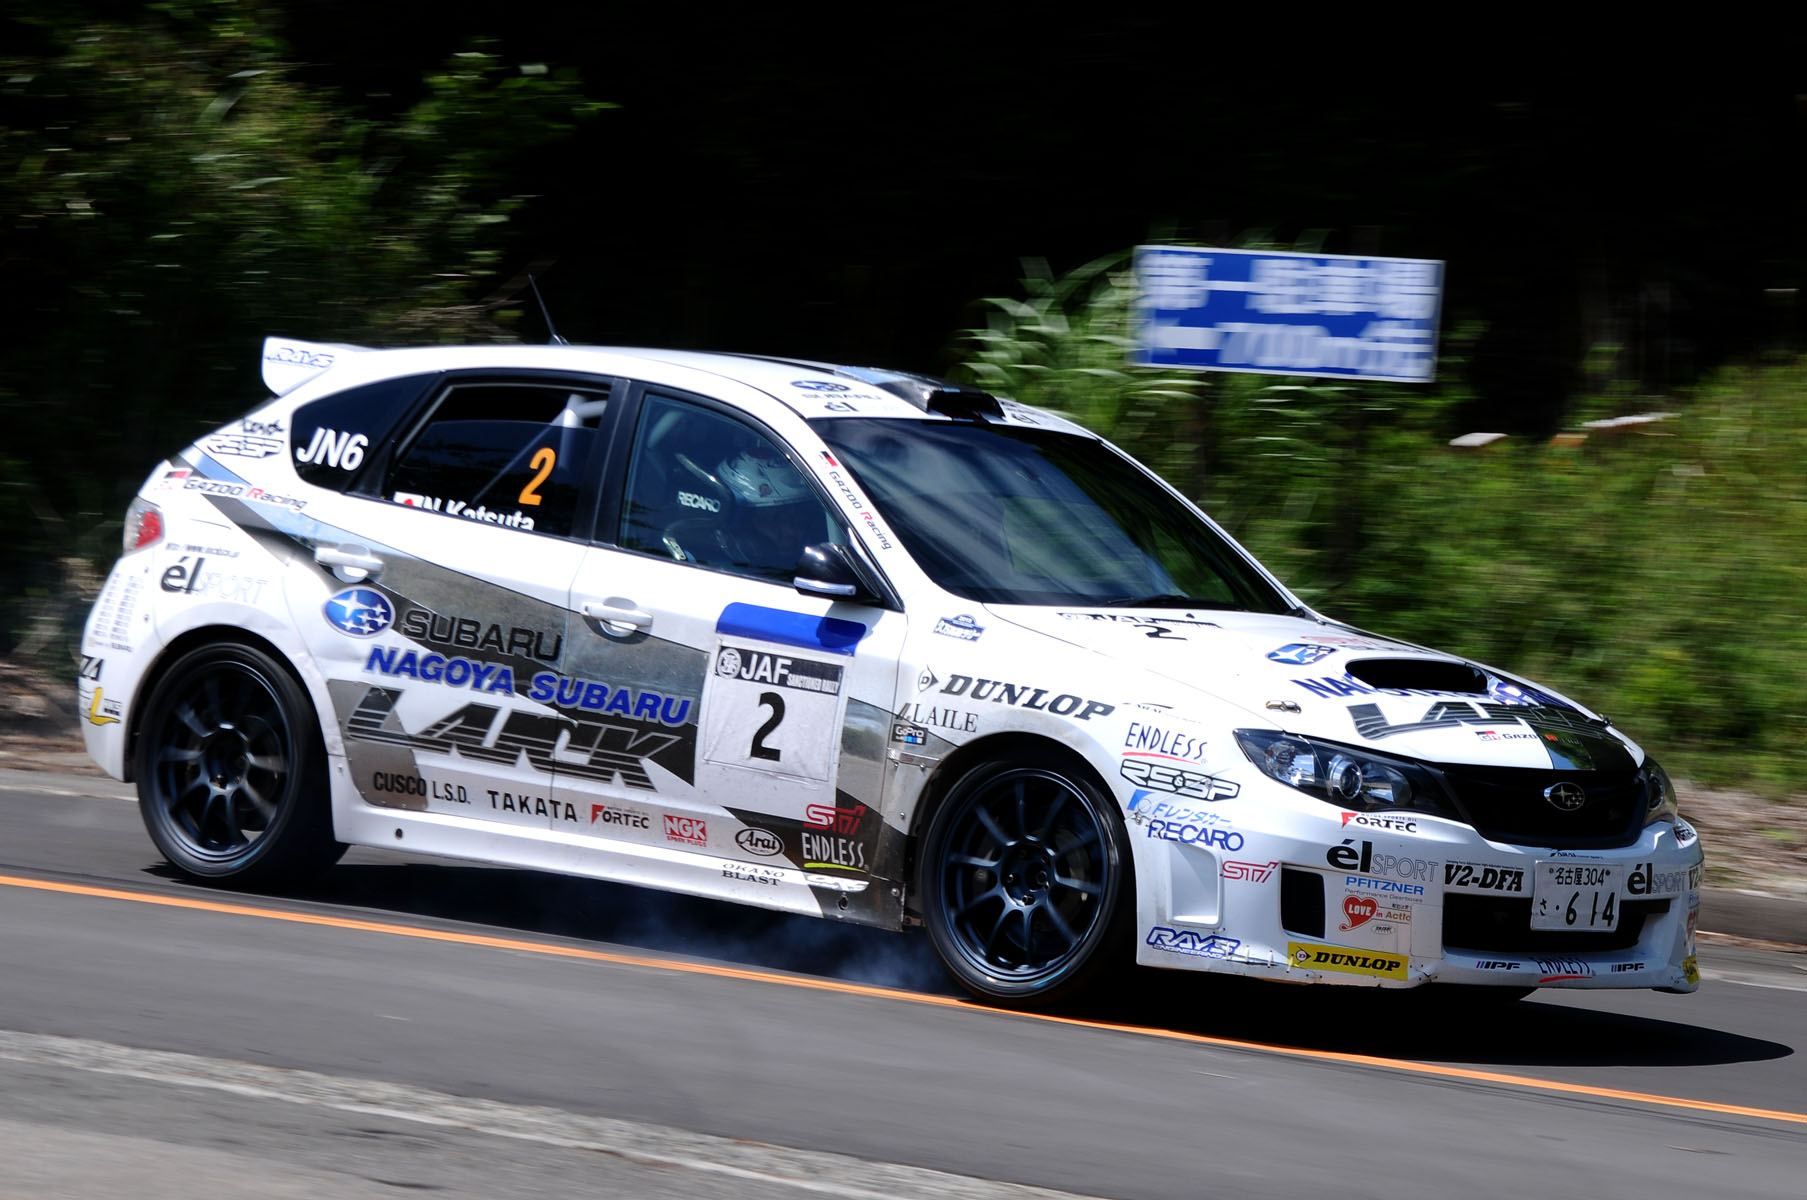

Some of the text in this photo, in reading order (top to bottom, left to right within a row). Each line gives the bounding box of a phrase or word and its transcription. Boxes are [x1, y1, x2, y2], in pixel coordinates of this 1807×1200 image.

[296, 427, 369, 470] JN6
[518, 447, 556, 506] 2
[245, 488, 308, 511] Racing
[860, 511, 893, 551] Racing
[402, 609, 563, 662] SUBARU
[741, 653, 792, 684] JAF
[365, 646, 693, 726] NAGOYA SUBARU
[939, 673, 1116, 721] DUNLOP
[750, 692, 785, 762] 2
[896, 726, 924, 738] GoPro
[1124, 721, 1209, 761] ENDLESS
[373, 771, 471, 806] CUSCO L.S.D.
[487, 790, 578, 823] TAKATA
[591, 804, 650, 829] FORTEC
[664, 815, 707, 841] NGK
[1148, 819, 1244, 851] RECARO
[1341, 812, 1417, 833] FORTEC
[740, 831, 777, 850] Arai
[801, 832, 865, 868] ENDLESS
[722, 863, 785, 878] OKANO
[1326, 838, 1439, 883] él SPORT
[722, 870, 782, 886] BLAST
[1346, 876, 1424, 895] PFITZNER
[1444, 864, 1524, 892] V2-DFA
[1627, 863, 1687, 895] él SPORT
[1348, 903, 1372, 916] LOVE
[1146, 927, 1241, 957] RAYS
[1314, 951, 1401, 972] DUNLOP
